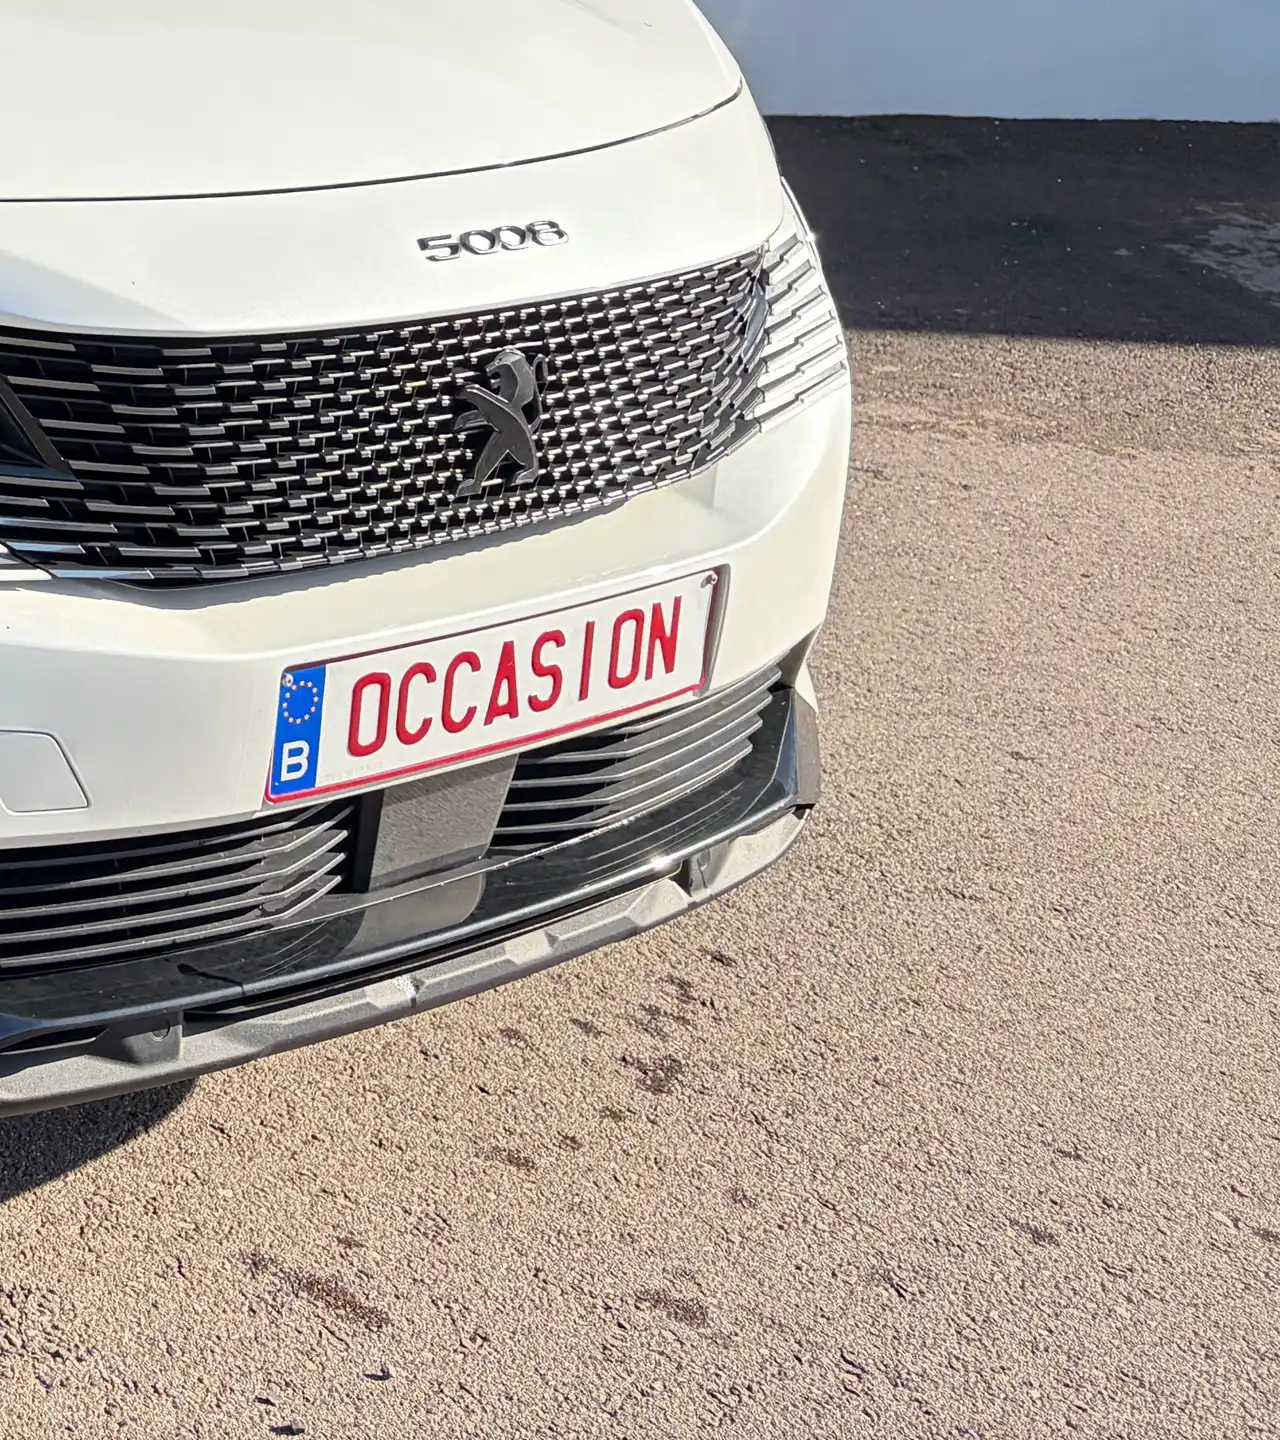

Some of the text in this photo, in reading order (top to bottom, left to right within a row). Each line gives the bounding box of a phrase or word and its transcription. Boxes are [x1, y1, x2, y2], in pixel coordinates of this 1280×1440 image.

[416, 220, 569, 262] 5008
[347, 595, 683, 757] OCCASION
[280, 740, 309, 782] B
